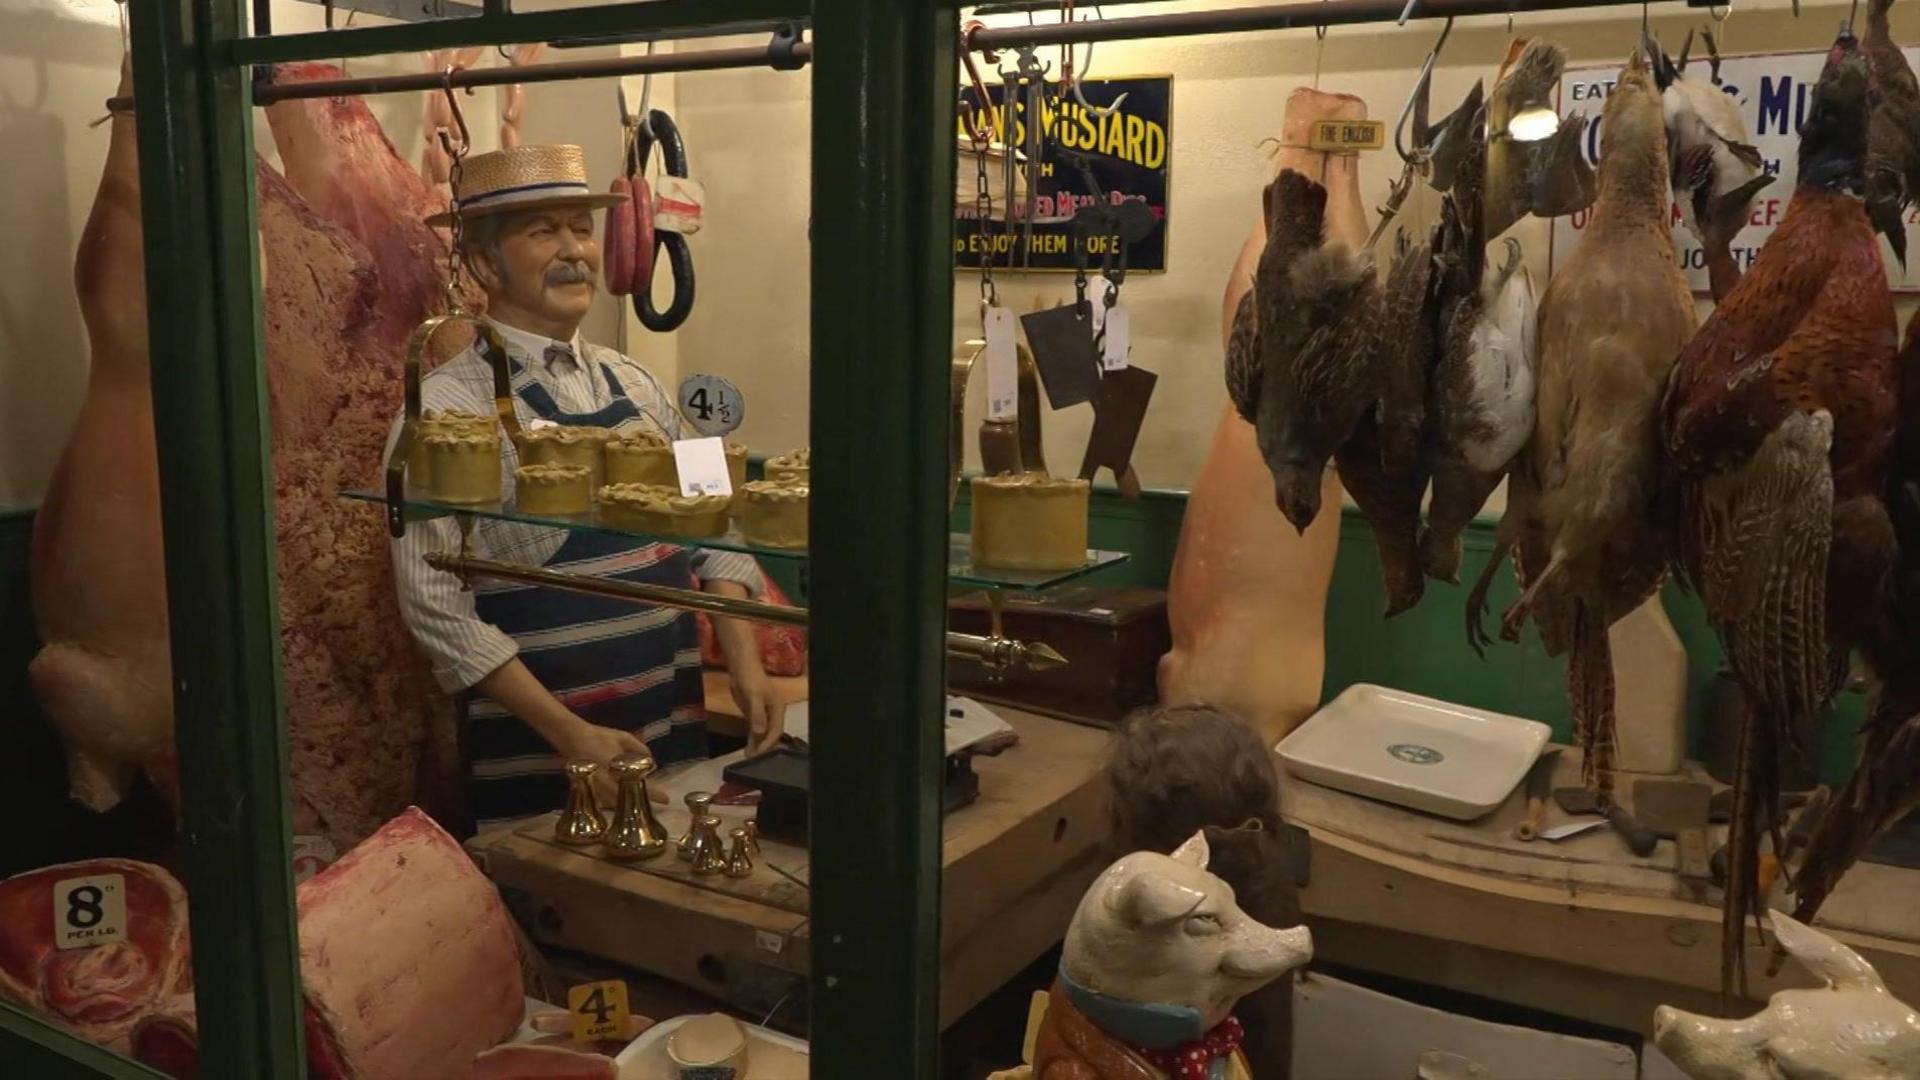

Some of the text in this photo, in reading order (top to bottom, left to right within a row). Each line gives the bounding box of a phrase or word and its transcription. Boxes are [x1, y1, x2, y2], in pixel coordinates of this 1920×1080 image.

[1572, 81, 1617, 100] EAT
[1036, 95, 1166, 170] MUSTARD
[67, 930, 95, 939] PER
[578, 988, 616, 1024] 4
